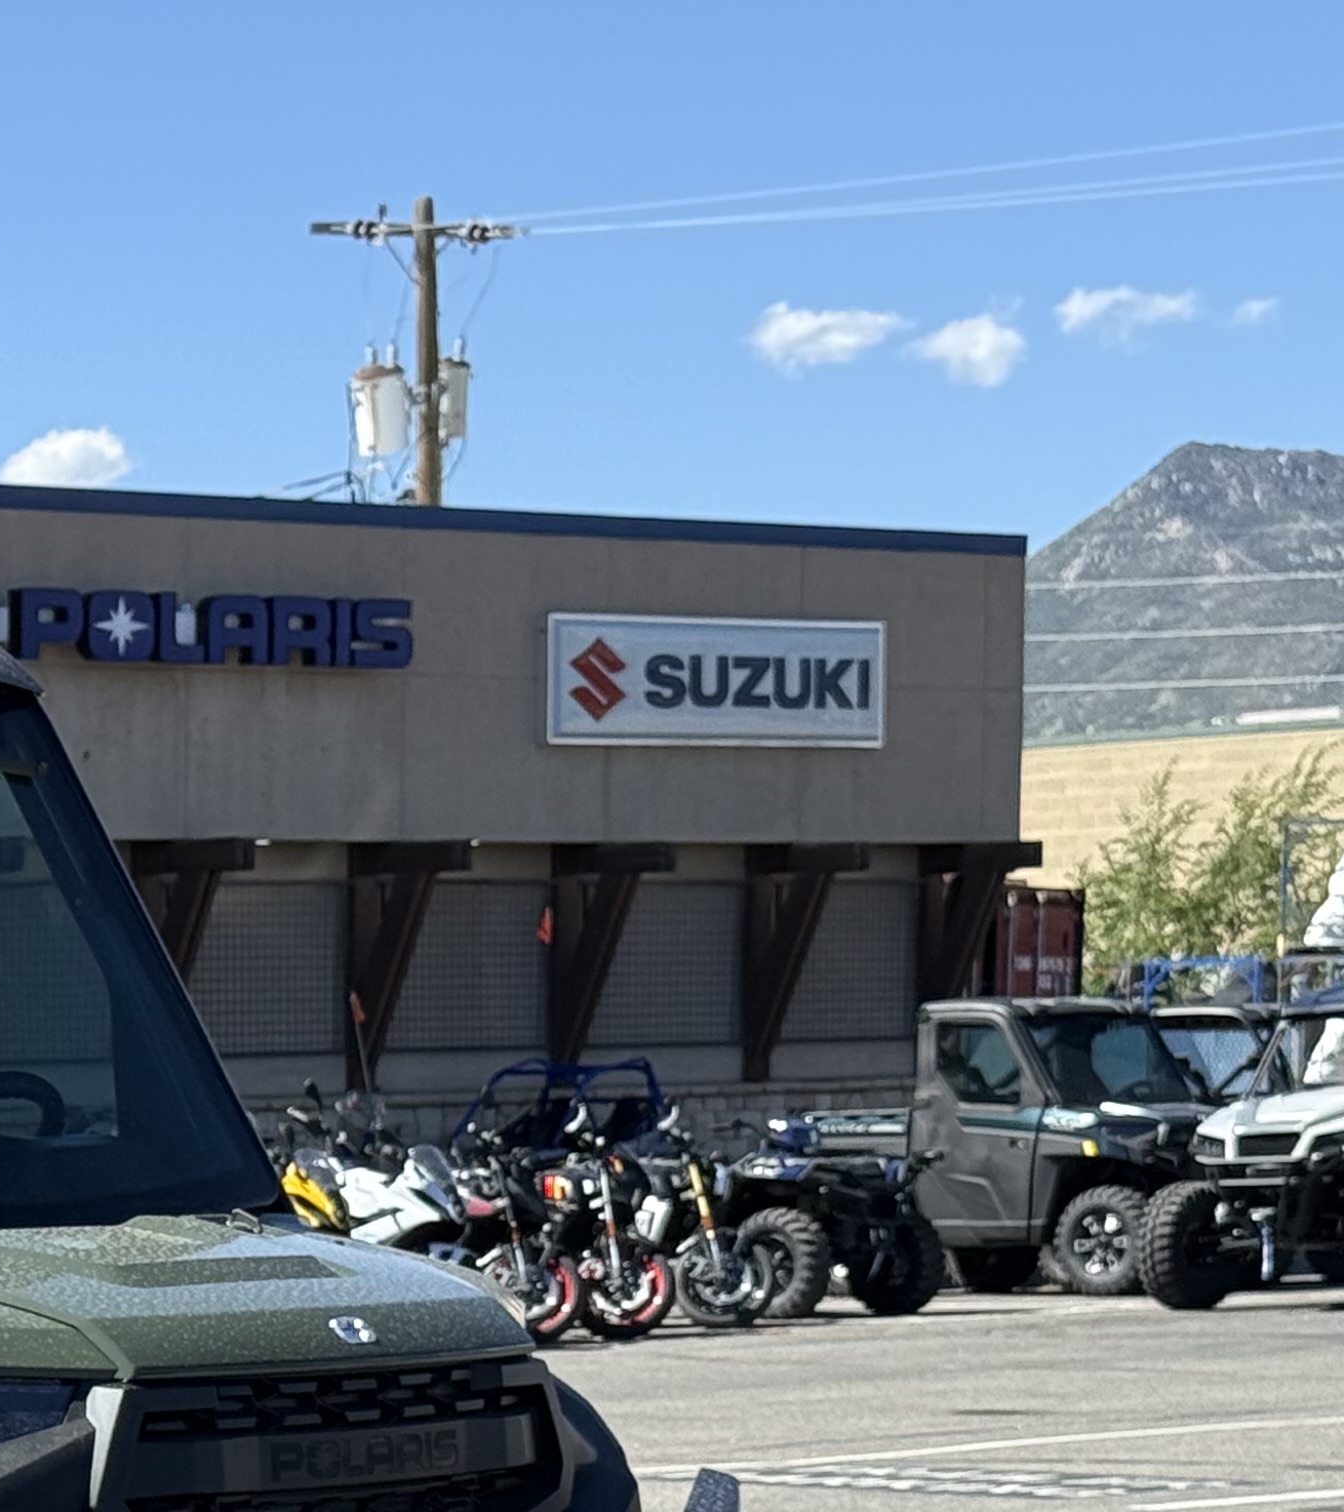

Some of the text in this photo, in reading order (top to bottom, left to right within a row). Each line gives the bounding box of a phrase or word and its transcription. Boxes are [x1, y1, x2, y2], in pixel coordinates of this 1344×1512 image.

[9, 588, 412, 668] POLARIS
[644, 654, 871, 709] SUZUKI
[269, 1429, 459, 1482] POLARIS
